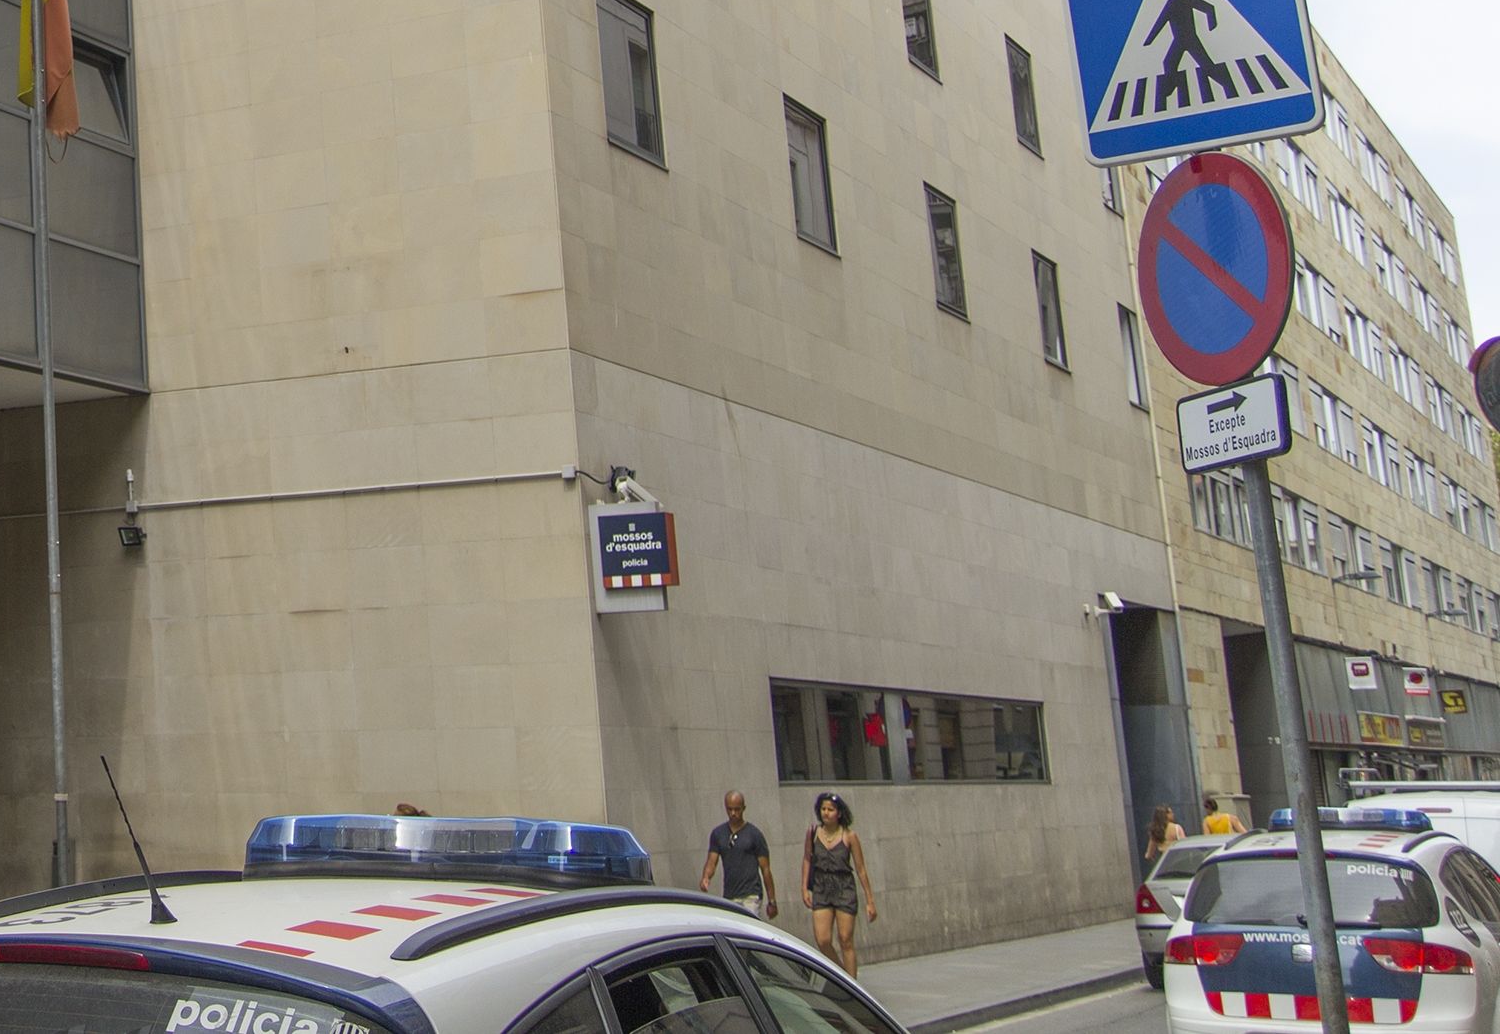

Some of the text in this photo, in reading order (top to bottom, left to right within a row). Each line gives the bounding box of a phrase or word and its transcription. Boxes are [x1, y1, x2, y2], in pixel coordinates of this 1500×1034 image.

[1208, 413, 1246, 433] Excepte
[1185, 429, 1277, 462] Mossos d'Esquadra
[612, 531, 654, 542] mossos
[605, 540, 662, 553] d'esquadra
[622, 558, 649, 569] policia
[1346, 864, 1398, 879] policia
[165, 998, 320, 1034] policia
